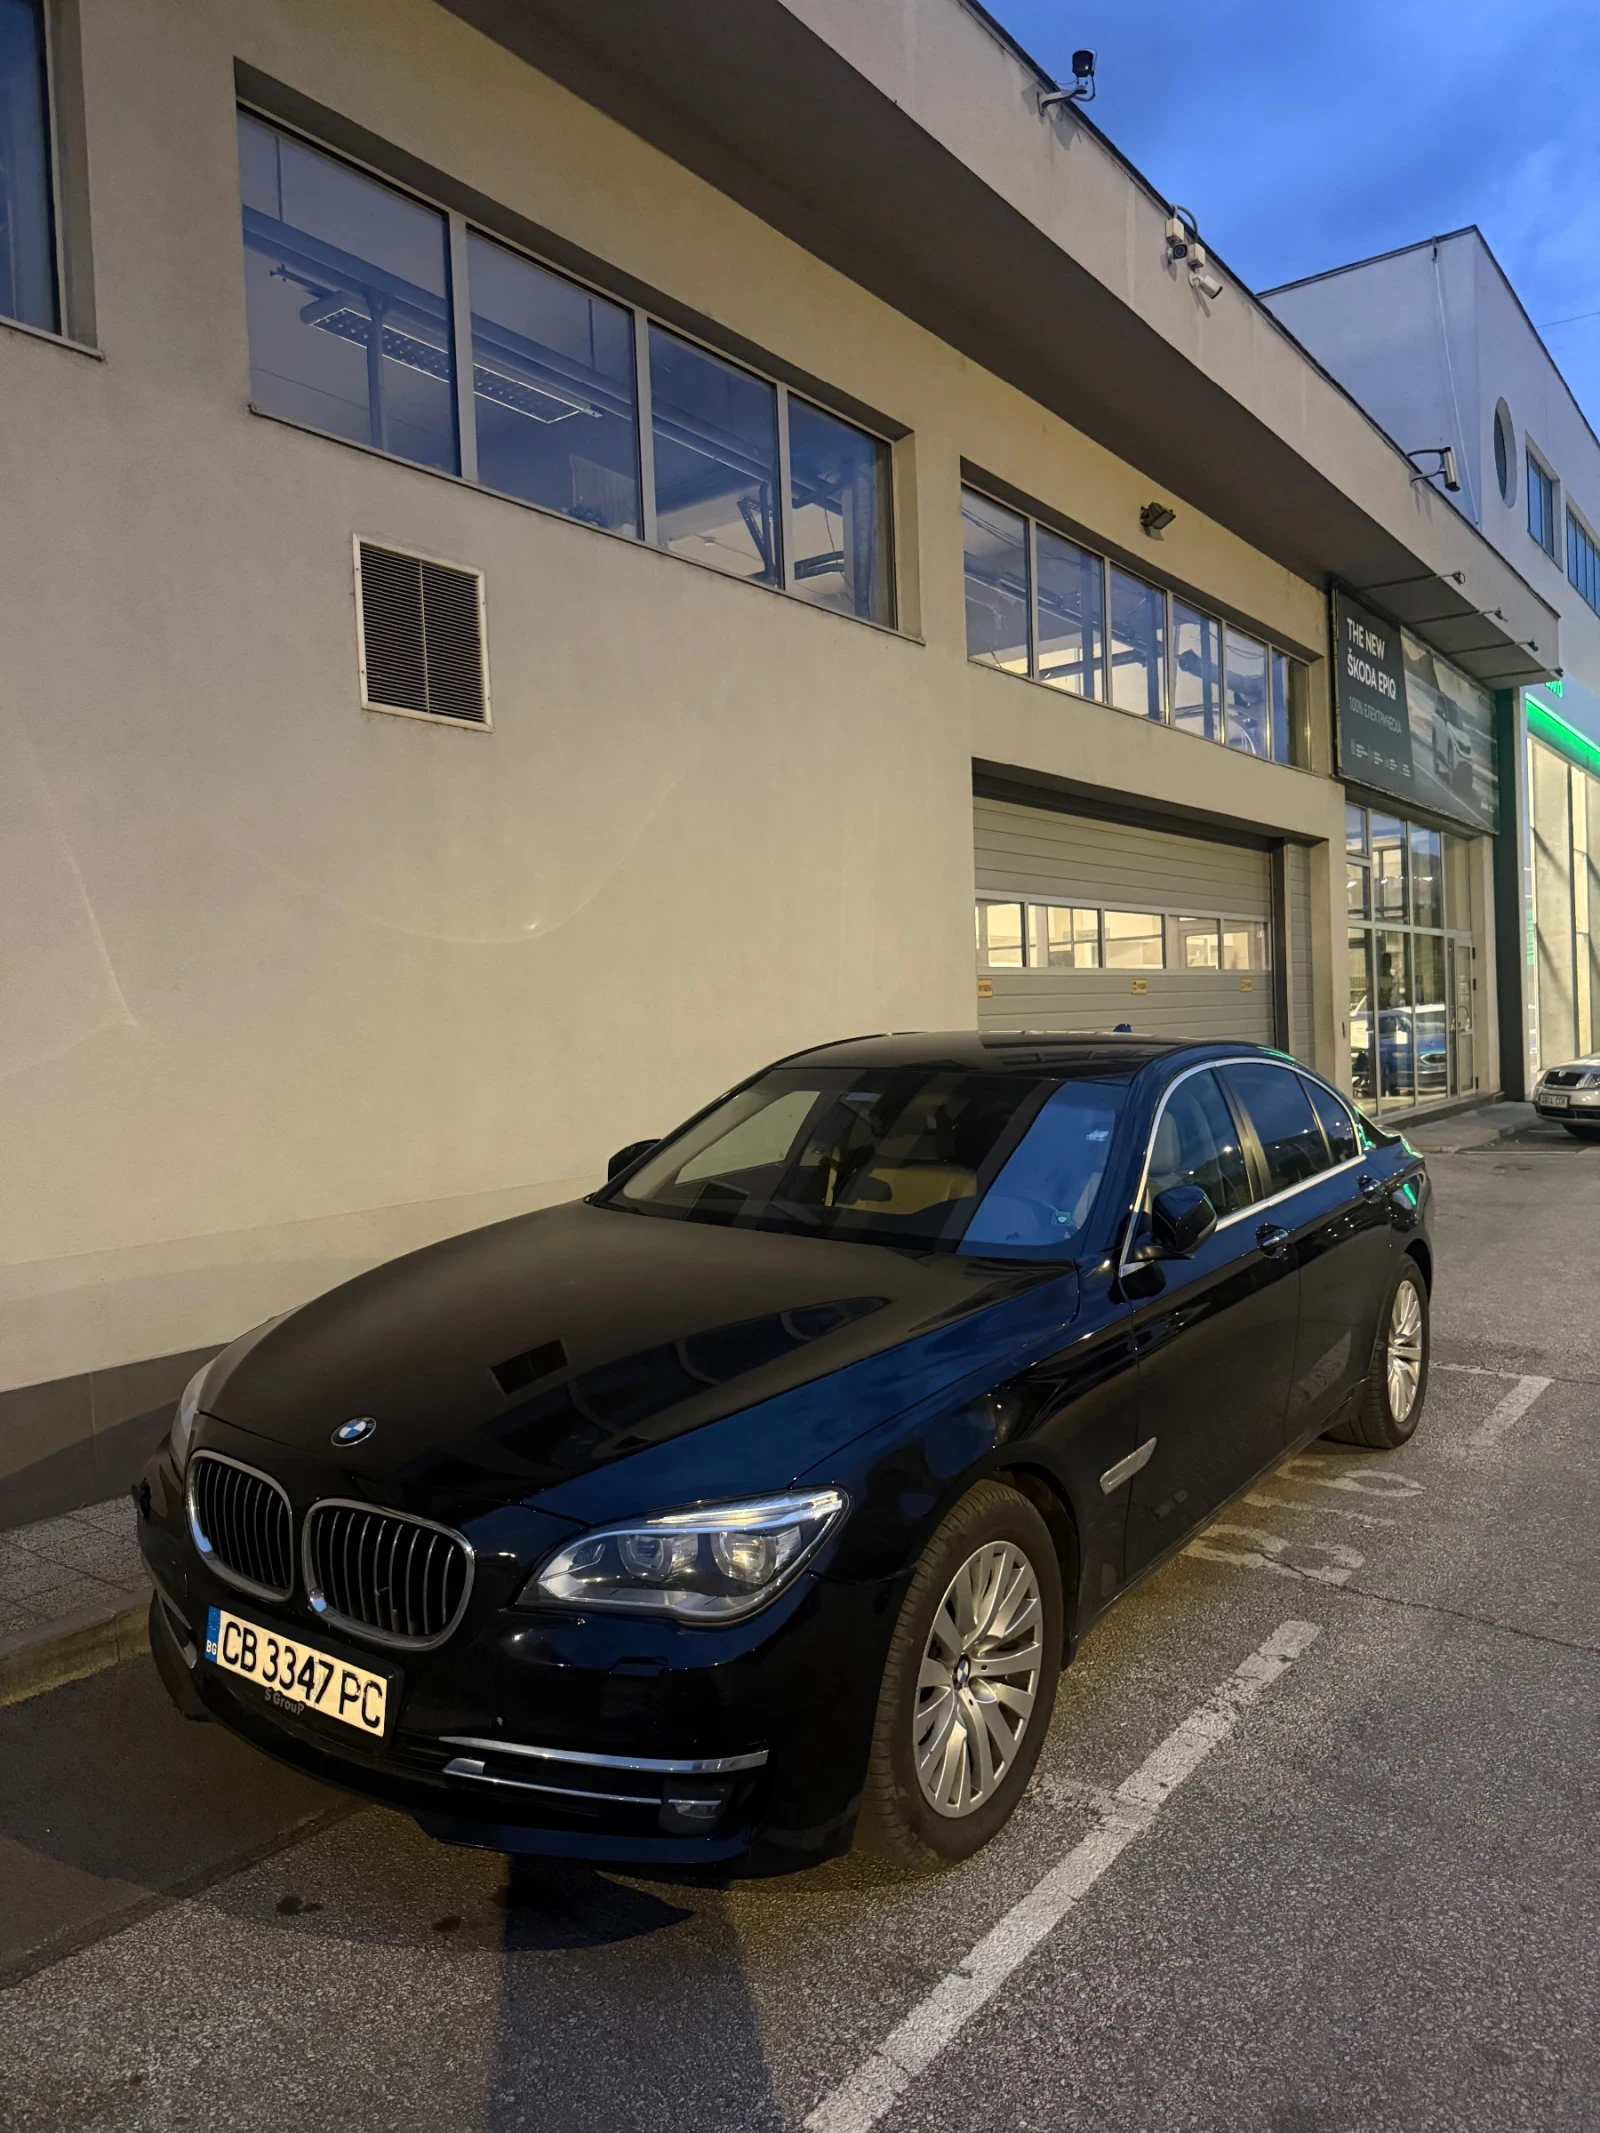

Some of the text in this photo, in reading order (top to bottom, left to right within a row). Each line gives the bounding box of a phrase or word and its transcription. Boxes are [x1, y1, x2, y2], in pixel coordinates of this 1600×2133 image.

[1347, 617, 1385, 660] THE NEW
[1347, 647, 1396, 700] ŠKODA EPIQ
[205, 1639, 217, 1656] BG
